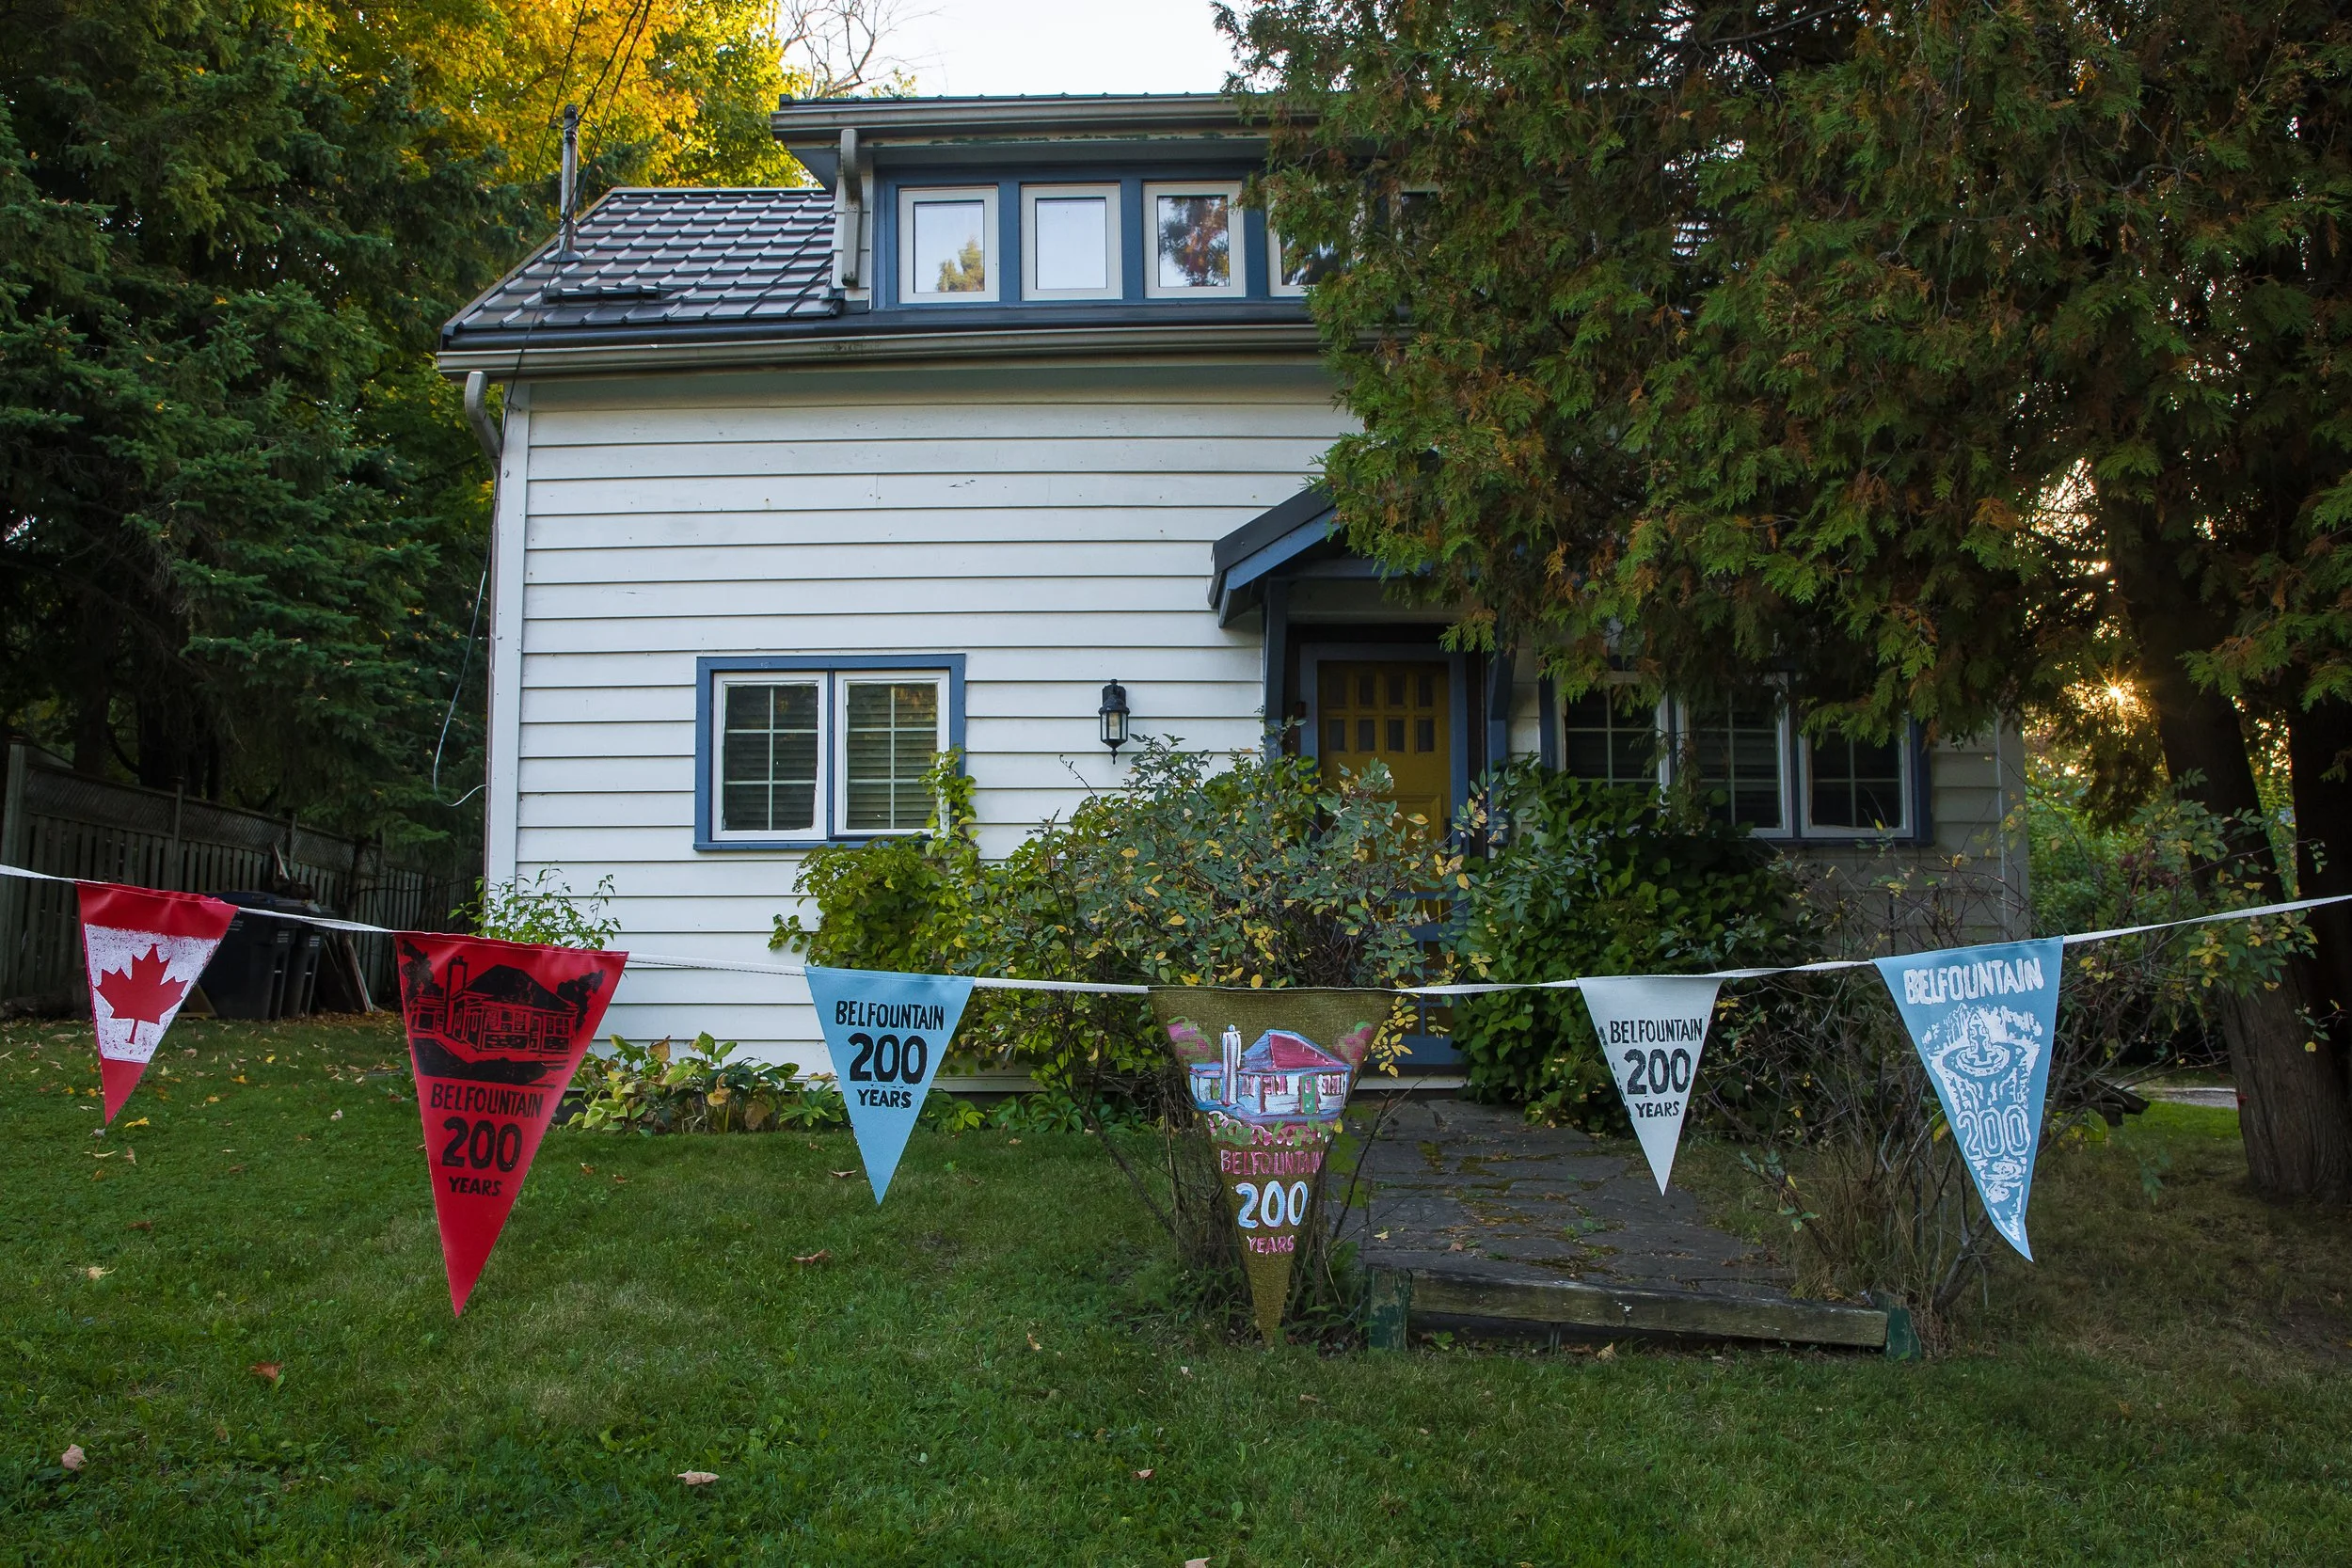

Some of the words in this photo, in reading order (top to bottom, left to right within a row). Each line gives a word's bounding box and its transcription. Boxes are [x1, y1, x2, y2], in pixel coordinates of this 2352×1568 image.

[1904, 958, 2043, 1005] BELFOUNTAIN
[835, 1001, 944, 1030] BELFOUNTAIN
[1610, 1019, 1703, 1043] BELFOUNTAIN
[848, 1033, 928, 1085] 200
[1624, 1048, 1691, 1094] 200
[430, 1083, 544, 1118] BELFOUNTAIN
[857, 1089, 912, 1108] YEARS
[1635, 1101, 1679, 1117] YEARS
[441, 1116, 522, 1173] 200
[1957, 1105, 2030, 1160] 200
[1221, 1149, 1324, 1176] BELFOUNTAIN
[449, 1176, 502, 1196] YEARS
[1235, 1180, 1308, 1228] 200
[1247, 1235, 1294, 1255] YEARS
